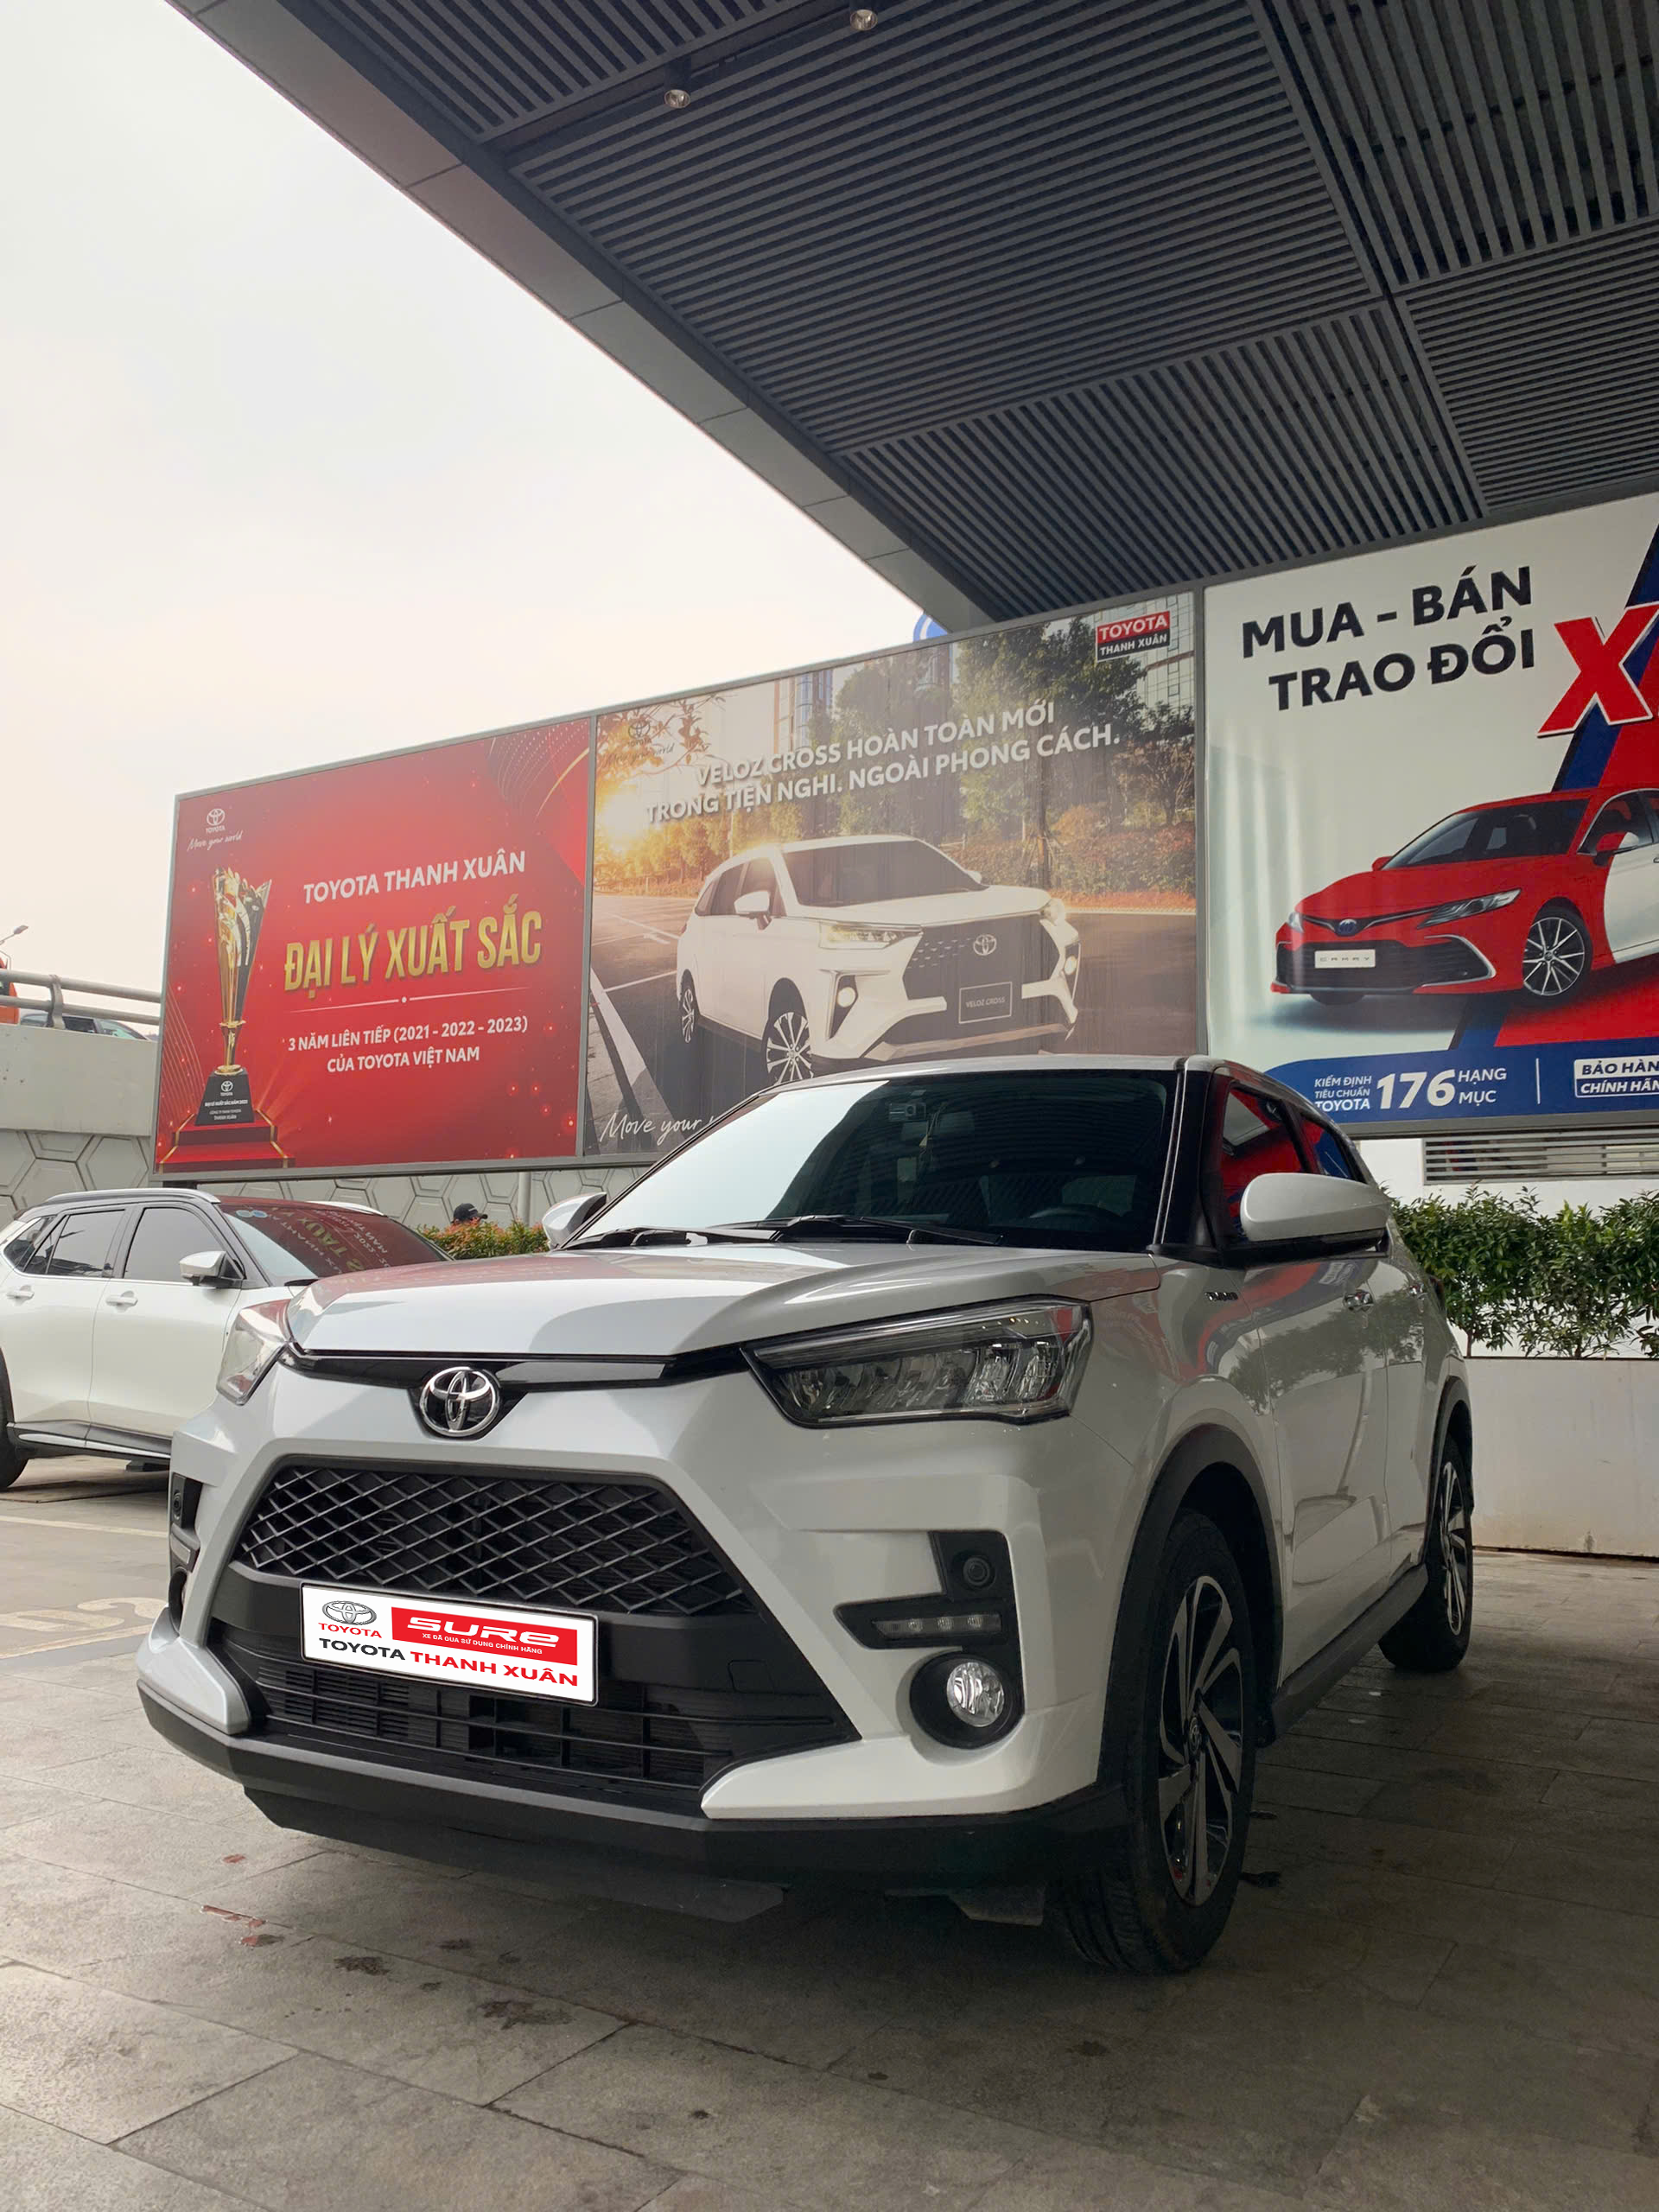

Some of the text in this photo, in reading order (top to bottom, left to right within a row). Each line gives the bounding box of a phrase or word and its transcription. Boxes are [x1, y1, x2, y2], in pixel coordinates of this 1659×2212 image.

[1243, 602, 1364, 658] MUA
[1412, 564, 1531, 626] BÁN
[1098, 614, 1167, 640] TOYOTA
[1100, 633, 1167, 656] THANH XUÂN
[1268, 616, 1534, 711] TRAO ĐỔI
[698, 698, 1054, 785] VELOZ CROSS HOÀN TOÀN MỚI
[645, 724, 1120, 824] TRONG TIỆN NGHI. NGOÀI PHONG CÁCH.
[303, 848, 525, 904] TOYOTA THANH XUÂN
[284, 893, 542, 999] ĐẠI LÝ XUẤT SẮC
[288, 1038, 296, 1052] 3
[298, 1033, 329, 1051] NĂM
[331, 1029, 361, 1048] LIÊN
[363, 1025, 391, 1045] TIẾP
[393, 1024, 429, 1044] (2021
[442, 1020, 475, 1038] 2022
[487, 1015, 528, 1034] 2023)
[327, 1046, 480, 1072] CỦA TOYOTA VIỆT NAM
[1582, 1060, 1618, 1075] BẢO
[1314, 1069, 1456, 1109] KIỂM ĐỊNH 176
[1458, 1068, 1507, 1084] HẠNG
[1580, 1079, 1628, 1094] CHÍNH
[1314, 1089, 1335, 1099] TIÊU
[1314, 1098, 1370, 1112] TOYOTA
[1459, 1090, 1497, 1106] MỤC
[599, 1112, 702, 1146] Move your
[318, 1623, 382, 1638] TOYOTA
[319, 1638, 578, 1687] TOYOTA THANH XUÂN
